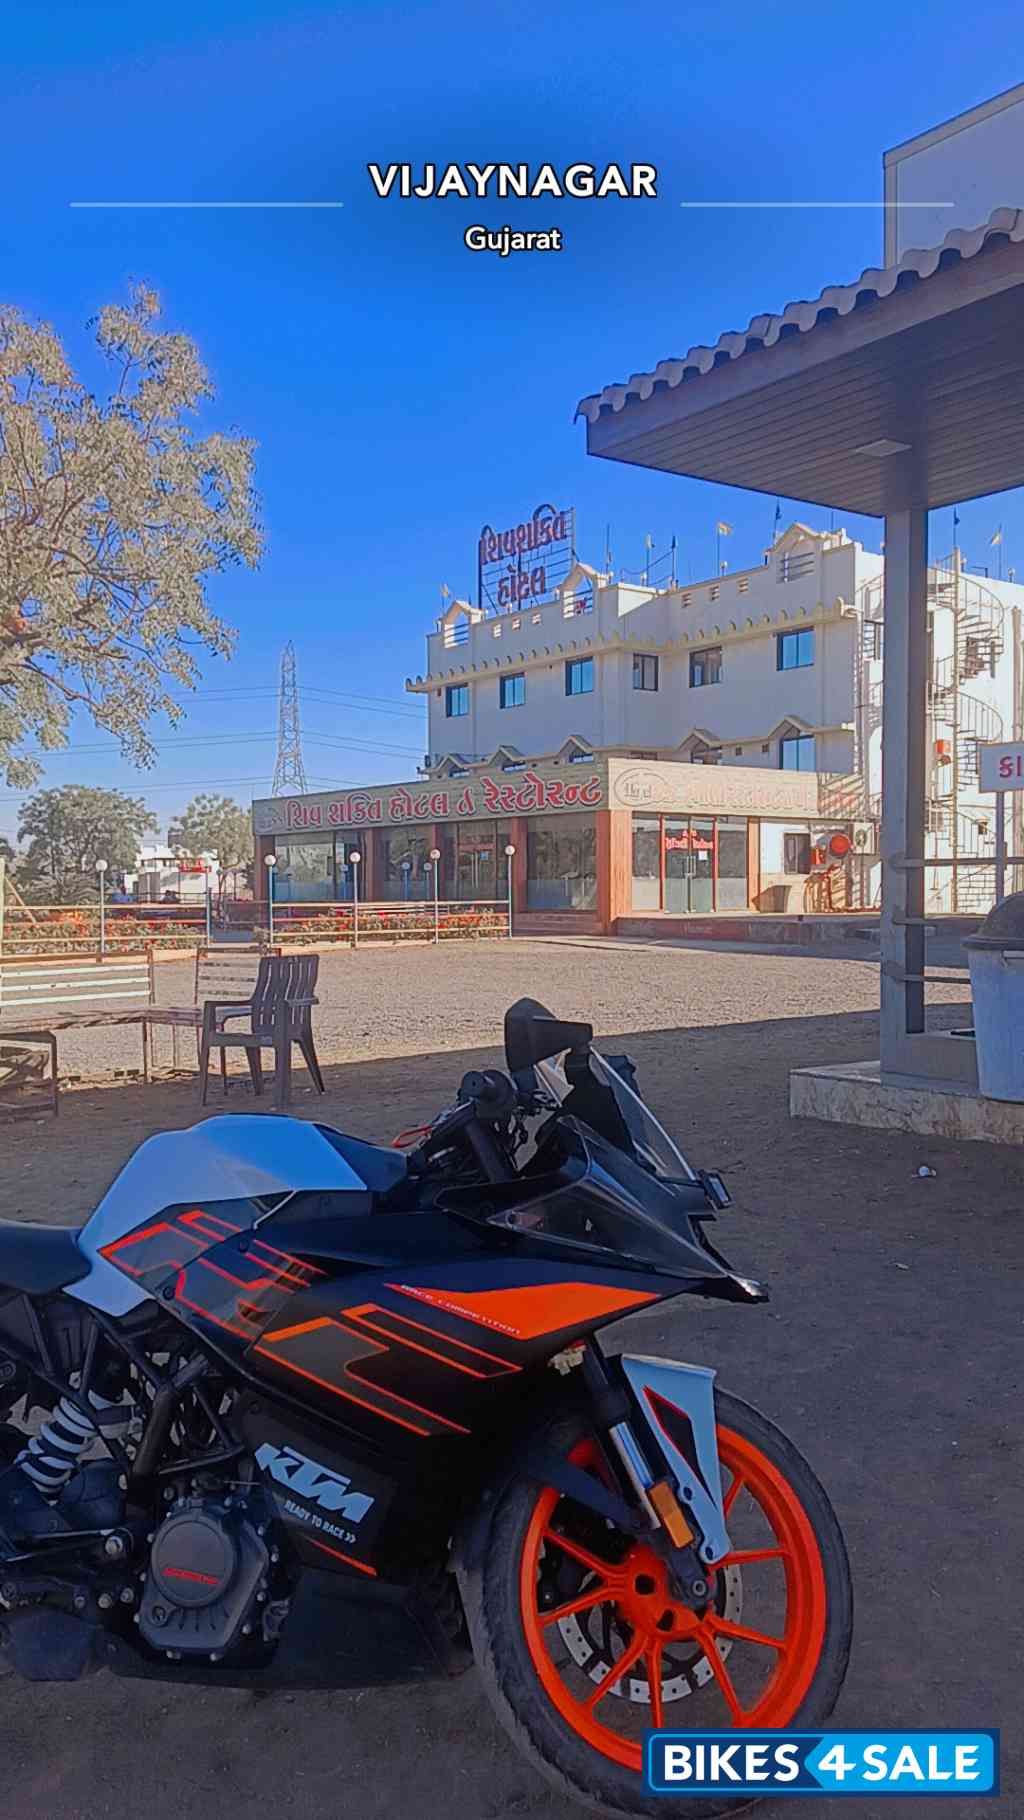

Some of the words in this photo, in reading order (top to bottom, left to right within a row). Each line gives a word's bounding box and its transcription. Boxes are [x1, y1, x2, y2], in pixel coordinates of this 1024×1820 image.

[286, 799, 322, 830] શિવ
[388, 786, 449, 820] હોટલ
[481, 771, 602, 812] રેસ્ટોરન્ટ
[255, 1443, 375, 1523] KTM
[284, 1500, 311, 1520] READY
[311, 1514, 323, 1528] TO
[322, 1520, 345, 1539] RACE
